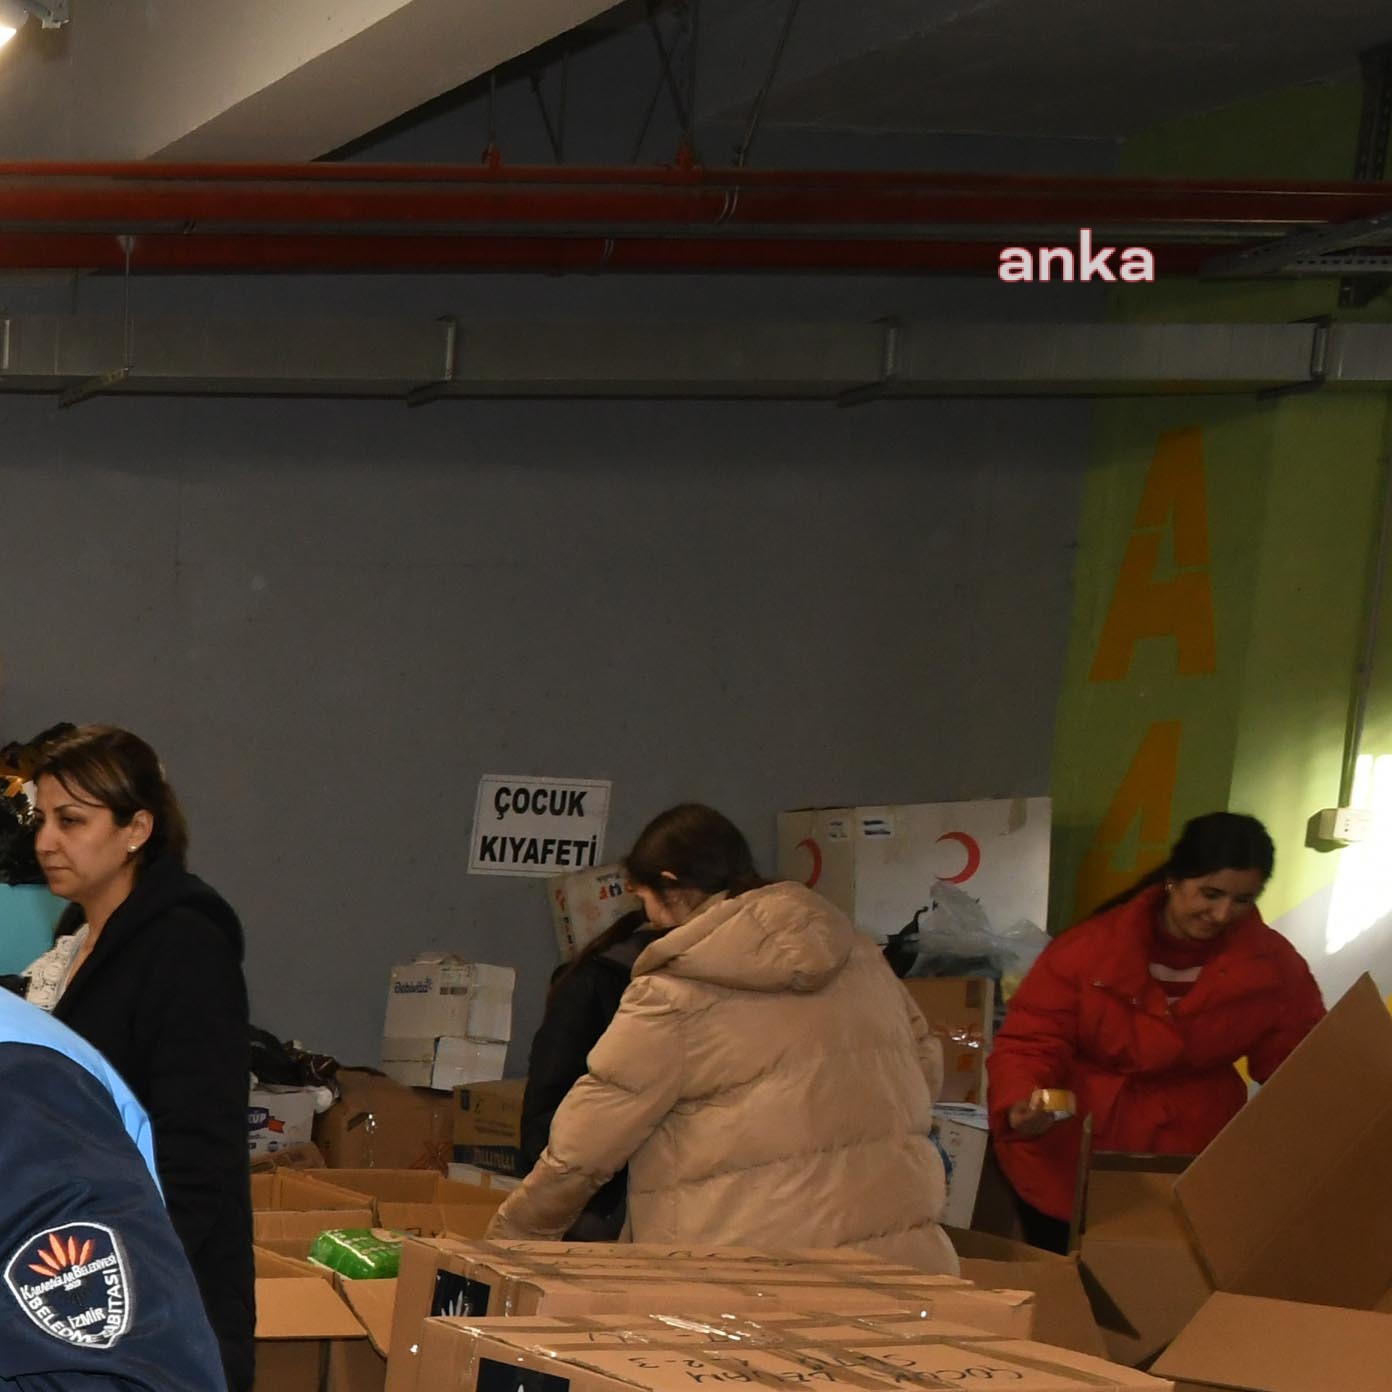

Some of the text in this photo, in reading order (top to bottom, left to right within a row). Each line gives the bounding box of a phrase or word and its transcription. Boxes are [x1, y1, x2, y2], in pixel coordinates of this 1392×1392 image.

[494, 787, 587, 820] ÇOCUK
[479, 834, 597, 866] KIYAFETİ
[67, 1307, 106, 1330] İZMİR
